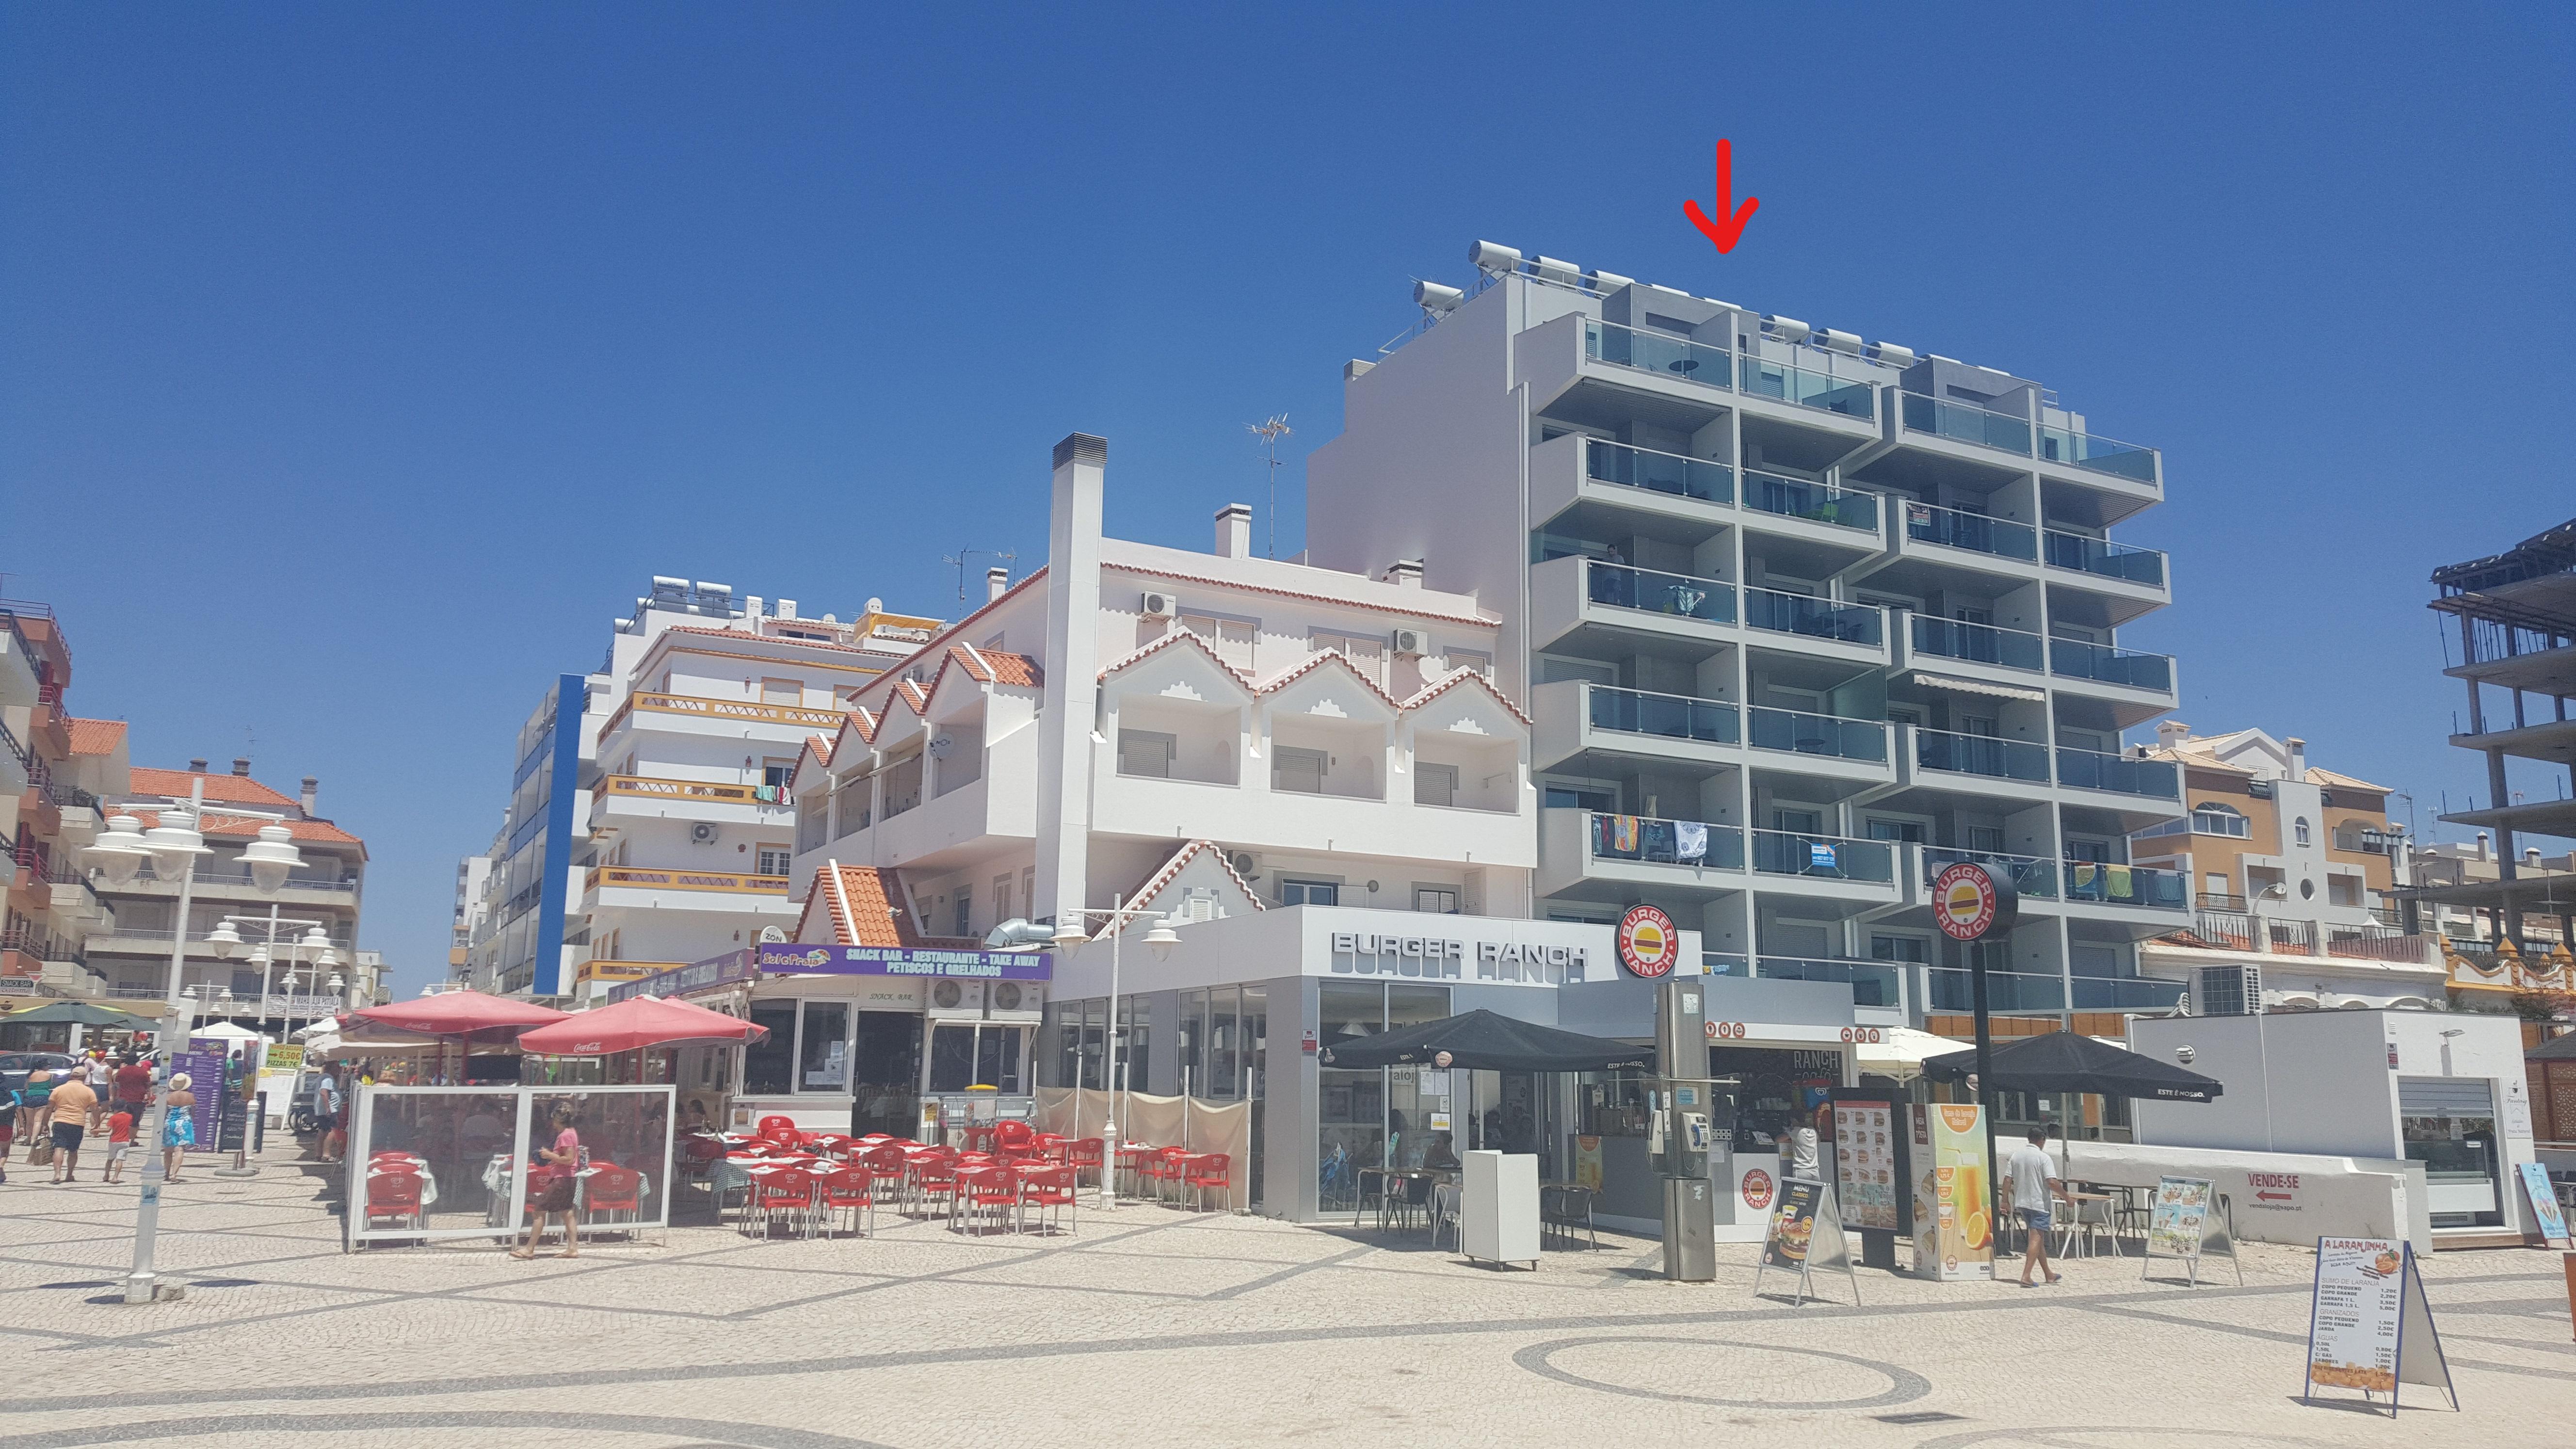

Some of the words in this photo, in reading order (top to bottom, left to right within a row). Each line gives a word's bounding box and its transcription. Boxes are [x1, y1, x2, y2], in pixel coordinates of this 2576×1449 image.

[1936, 867, 1991, 904] BURGER
[1622, 909, 1674, 942] BURGER
[1938, 907, 1993, 937] RANCH
[1332, 932, 1465, 959] BURGER
[1478, 941, 1588, 966] RANCH
[846, 948, 881, 961] SNACK
[882, 950, 902, 962] BAR
[912, 950, 980, 965] RESTAURANTE
[989, 954, 1013, 966] TAKE
[1014, 955, 1041, 967] AWAY
[1623, 947, 1673, 975] RANCH
[886, 962, 935, 974] PETISCOS
[936, 964, 945, 974] E
[946, 964, 1002, 977] GRELHADOS
[574, 1042, 601, 1052] Coca-Cola
[279, 1052, 301, 1060] 6,50€
[1794, 1051, 1838, 1069] RANCH
[1744, 1171, 1771, 1188] BURGER
[2247, 1173, 2299, 1189] VENDE-SE
[1793, 1184, 1809, 1192] MENU
[1745, 1193, 1771, 1208] RANCH
[2249, 1203, 2302, 1211] vendaloja@sapo.pt
[2324, 1240, 2331, 1249] A
[2333, 1240, 2388, 1253] LARANJINHA
